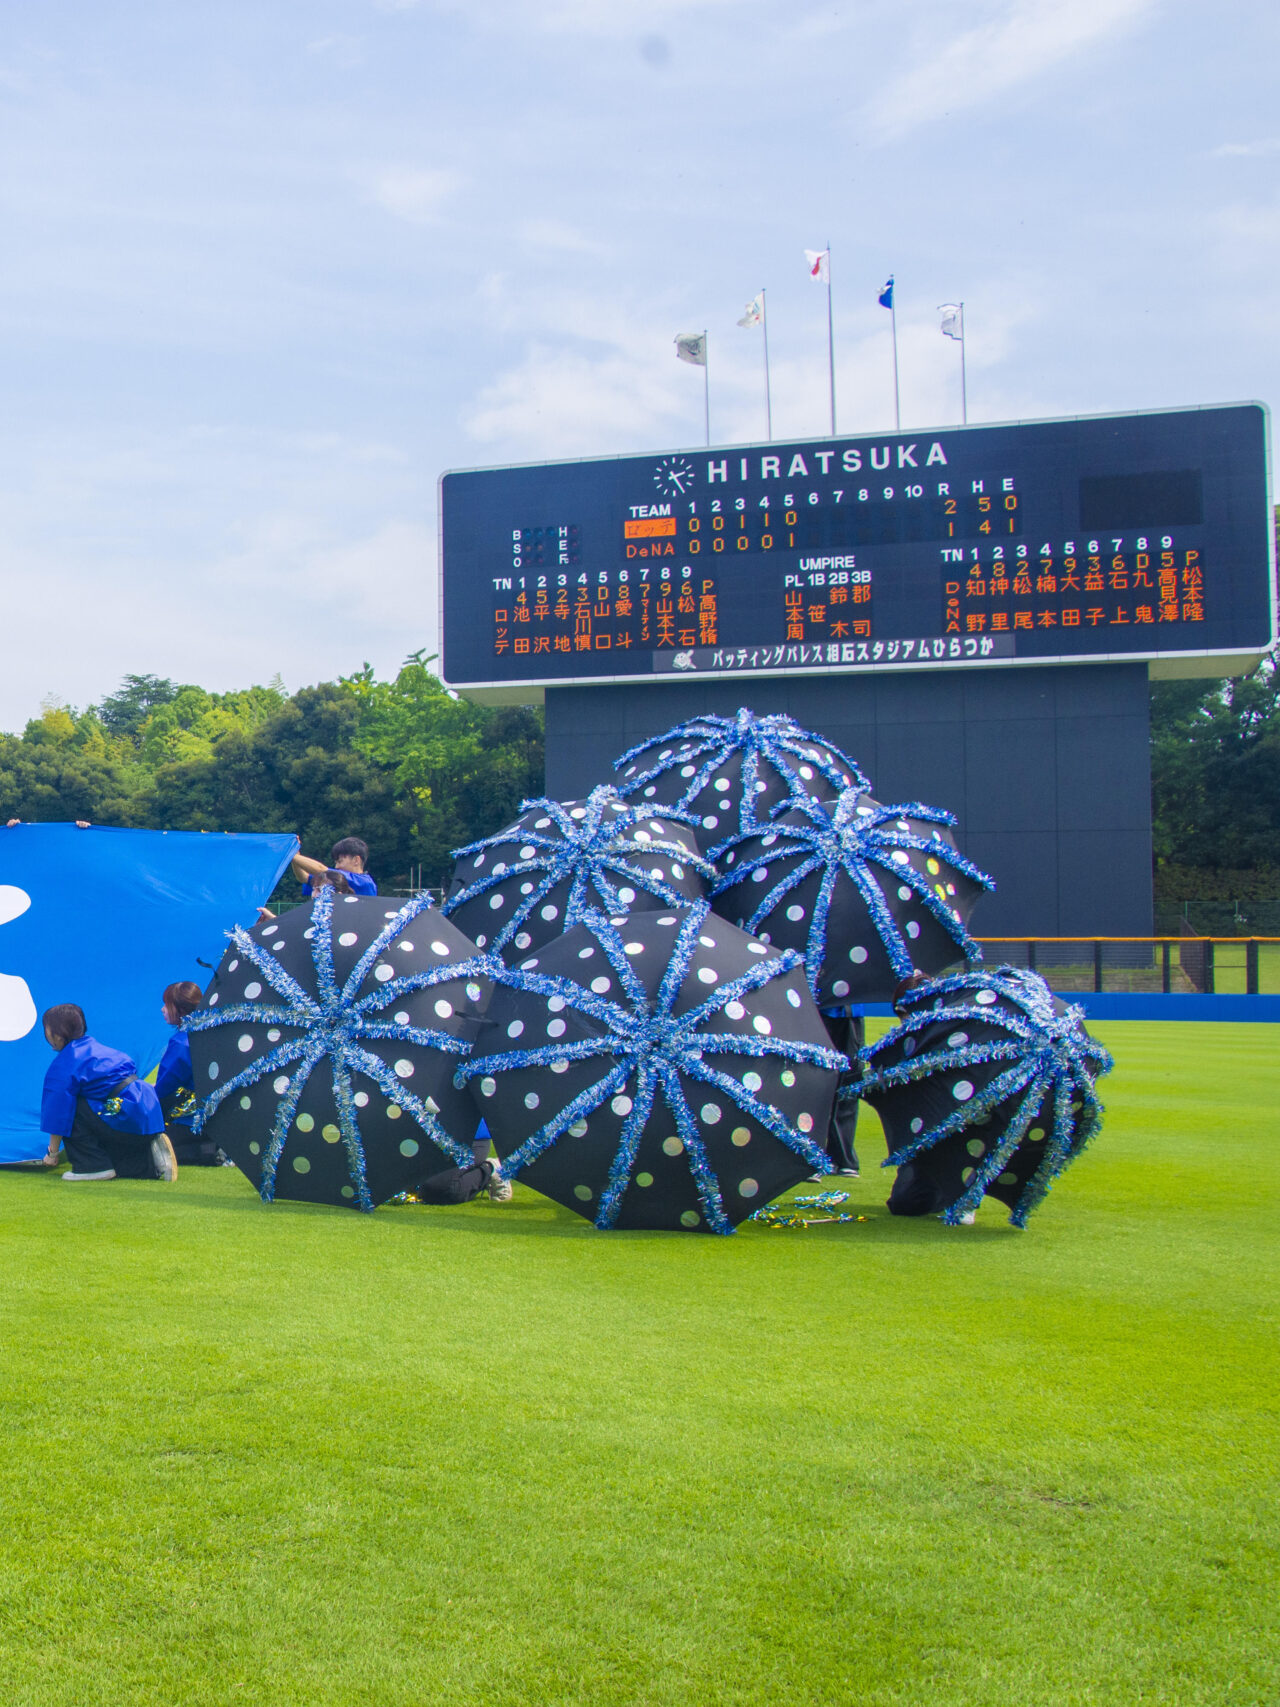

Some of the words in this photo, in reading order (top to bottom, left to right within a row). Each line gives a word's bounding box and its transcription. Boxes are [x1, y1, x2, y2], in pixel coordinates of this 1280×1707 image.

[708, 442, 948, 483] HIRATSUKA
[627, 522, 673, 536] ロッテ
[689, 518, 700, 532] 0
[713, 516, 724, 530] 0
[786, 511, 797, 525] 0
[945, 499, 956, 514] 2
[979, 497, 991, 511] 5
[1006, 495, 1017, 510] 0
[629, 504, 671, 518] TEAM
[711, 499, 722, 512] 2
[735, 497, 746, 510] 3
[760, 496, 770, 508] 4
[784, 493, 795, 507] 5
[809, 492, 819, 504] 6
[833, 489, 844, 503] 7
[859, 489, 869, 500] 8
[884, 487, 894, 499] 9
[906, 485, 923, 497] 10
[939, 483, 949, 495] R
[973, 480, 984, 493] H
[1004, 478, 1014, 490] E
[512, 529, 522, 541] B
[513, 543, 522, 554] S
[558, 526, 568, 537] H
[559, 539, 568, 551] E
[627, 542, 674, 558] DeNA
[690, 539, 700, 553] 0
[714, 538, 724, 552] 0
[738, 536, 748, 550] 0
[762, 534, 773, 548] 0
[980, 520, 991, 534] 4
[941, 548, 963, 561] TN
[971, 547, 979, 560] 1
[994, 546, 1004, 558] 2
[1017, 545, 1027, 557] 3
[1041, 543, 1051, 555] 4
[1065, 542, 1075, 554] 5
[1089, 540, 1099, 552] 6
[1112, 538, 1123, 551] 7
[1138, 537, 1148, 549] 8
[1162, 536, 1172, 548] 9
[493, 578, 511, 589] TN
[537, 575, 547, 588] 2
[557, 573, 568, 586] 3
[577, 572, 588, 585] 4
[598, 570, 609, 584] 5
[619, 569, 630, 582] 6
[639, 568, 650, 581] 7
[661, 567, 671, 580] 8
[681, 565, 692, 578] 9
[786, 575, 804, 587] PL
[809, 573, 825, 585] 1B
[829, 572, 849, 584] 2B
[852, 571, 872, 583] 3B
[799, 556, 855, 570] UMPIRE
[970, 564, 981, 578] 4
[994, 562, 1005, 577] 8
[1017, 561, 1029, 575] 2
[1041, 559, 1052, 575] 7
[1065, 558, 1076, 572] 9
[1089, 556, 1100, 571] 3
[1113, 555, 1125, 570] 6
[1137, 554, 1149, 568] D
[1162, 552, 1174, 567] 5
[1187, 550, 1199, 565] P
[517, 592, 527, 604] 4
[537, 590, 547, 604] 5
[557, 589, 568, 602] 2
[578, 587, 588, 601] 3
[598, 586, 608, 600] D
[619, 585, 629, 599] 8
[640, 584, 650, 597] 7
[661, 582, 671, 596] 9
[682, 581, 692, 596] 6
[703, 580, 714, 594] P
[786, 591, 804, 640] 山本周
[809, 605, 826, 622] 笹
[830, 587, 848, 637] 鈴木
[852, 585, 871, 636] 郡司
[946, 582, 960, 632] DeNA
[967, 579, 986, 631] 知野
[990, 577, 1009, 630] 神里
[1013, 576, 1033, 629] 松尾
[1037, 573, 1056, 627] 楠本
[1061, 574, 1080, 625] 大田
[1085, 572, 1105, 625] 益子
[1109, 571, 1129, 623] 石上
[1133, 570, 1154, 623] 九鬼
[1158, 568, 1179, 621] 高見澤
[1183, 564, 1204, 620] 松本隆
[495, 610, 509, 654] ロッテ
[514, 606, 530, 653] 池田
[534, 603, 550, 653] 平沢
[554, 603, 571, 652] 寺地
[574, 602, 591, 650] 石川慎
[595, 602, 611, 649] 山口
[615, 599, 632, 648] 愛斗
[657, 598, 674, 646] 山本大
[678, 596, 696, 645] 松石
